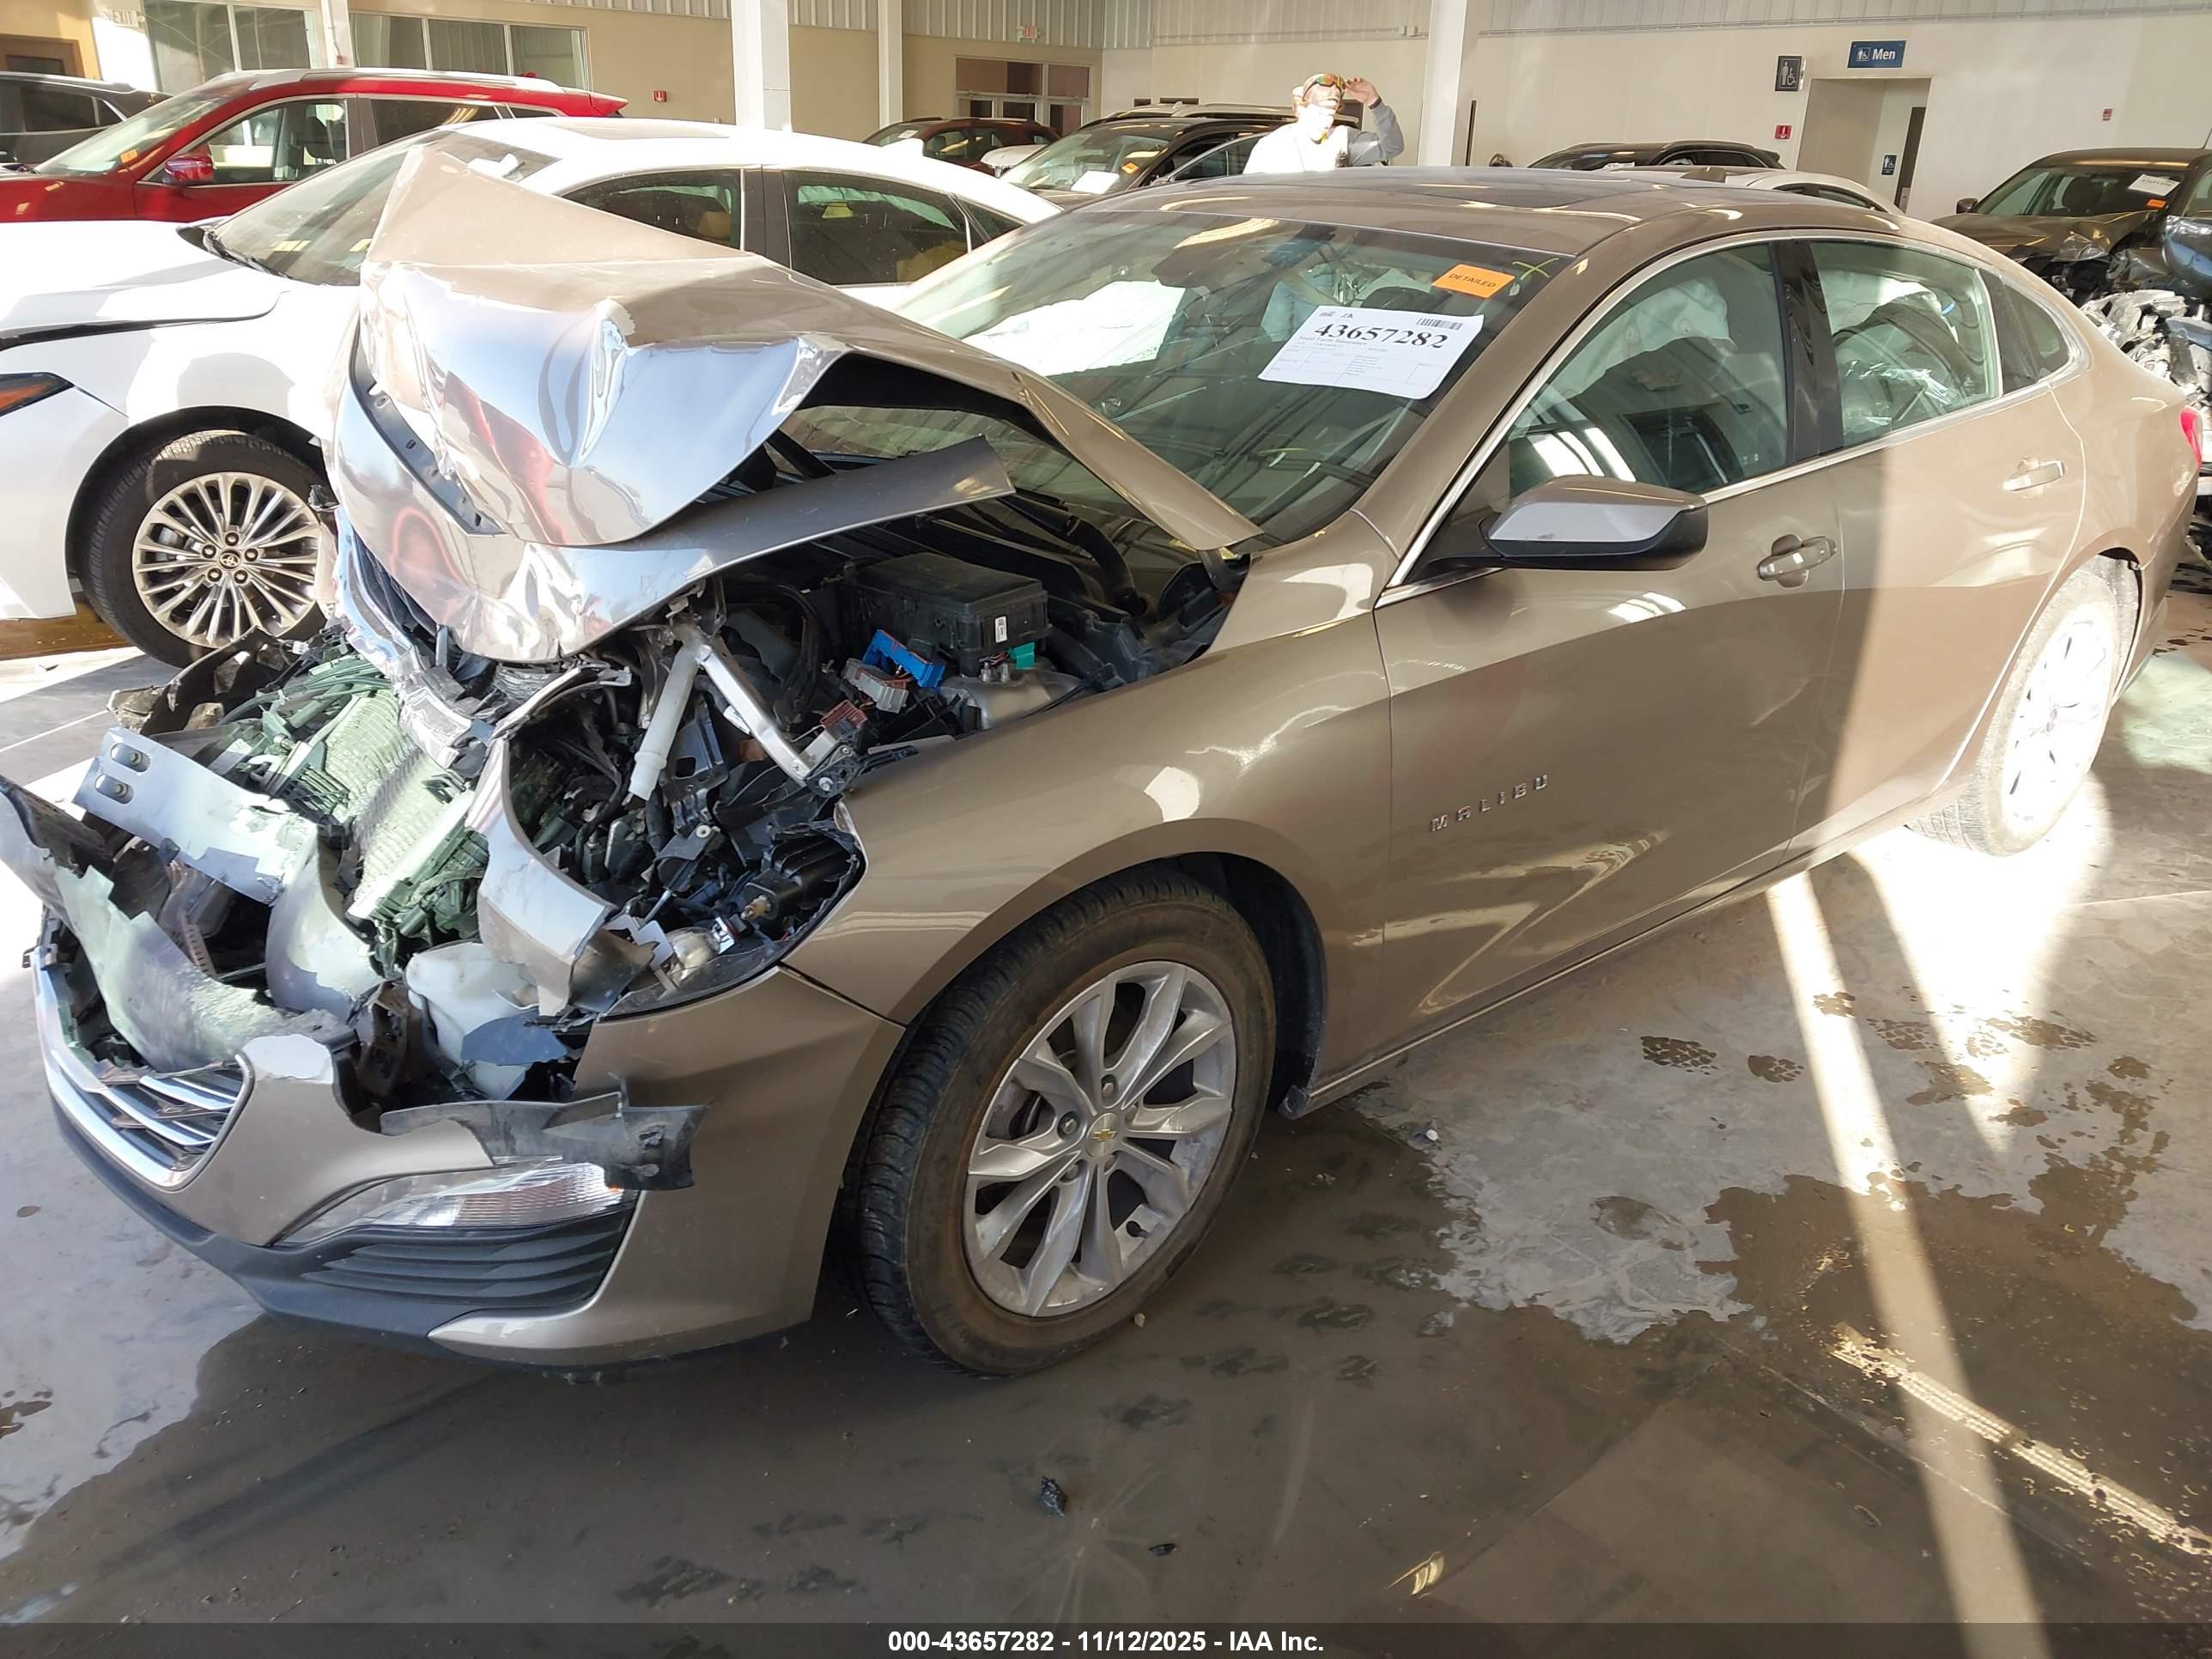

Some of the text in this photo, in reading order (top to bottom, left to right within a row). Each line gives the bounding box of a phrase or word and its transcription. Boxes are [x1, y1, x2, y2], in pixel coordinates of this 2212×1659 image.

[112, 9, 133, 24] EXIT
[1872, 48, 1896, 60] Men
[1449, 273, 1497, 288] DETAILED
[1314, 323, 1448, 349] 43657282
[1430, 774, 1548, 832] MALIBU
